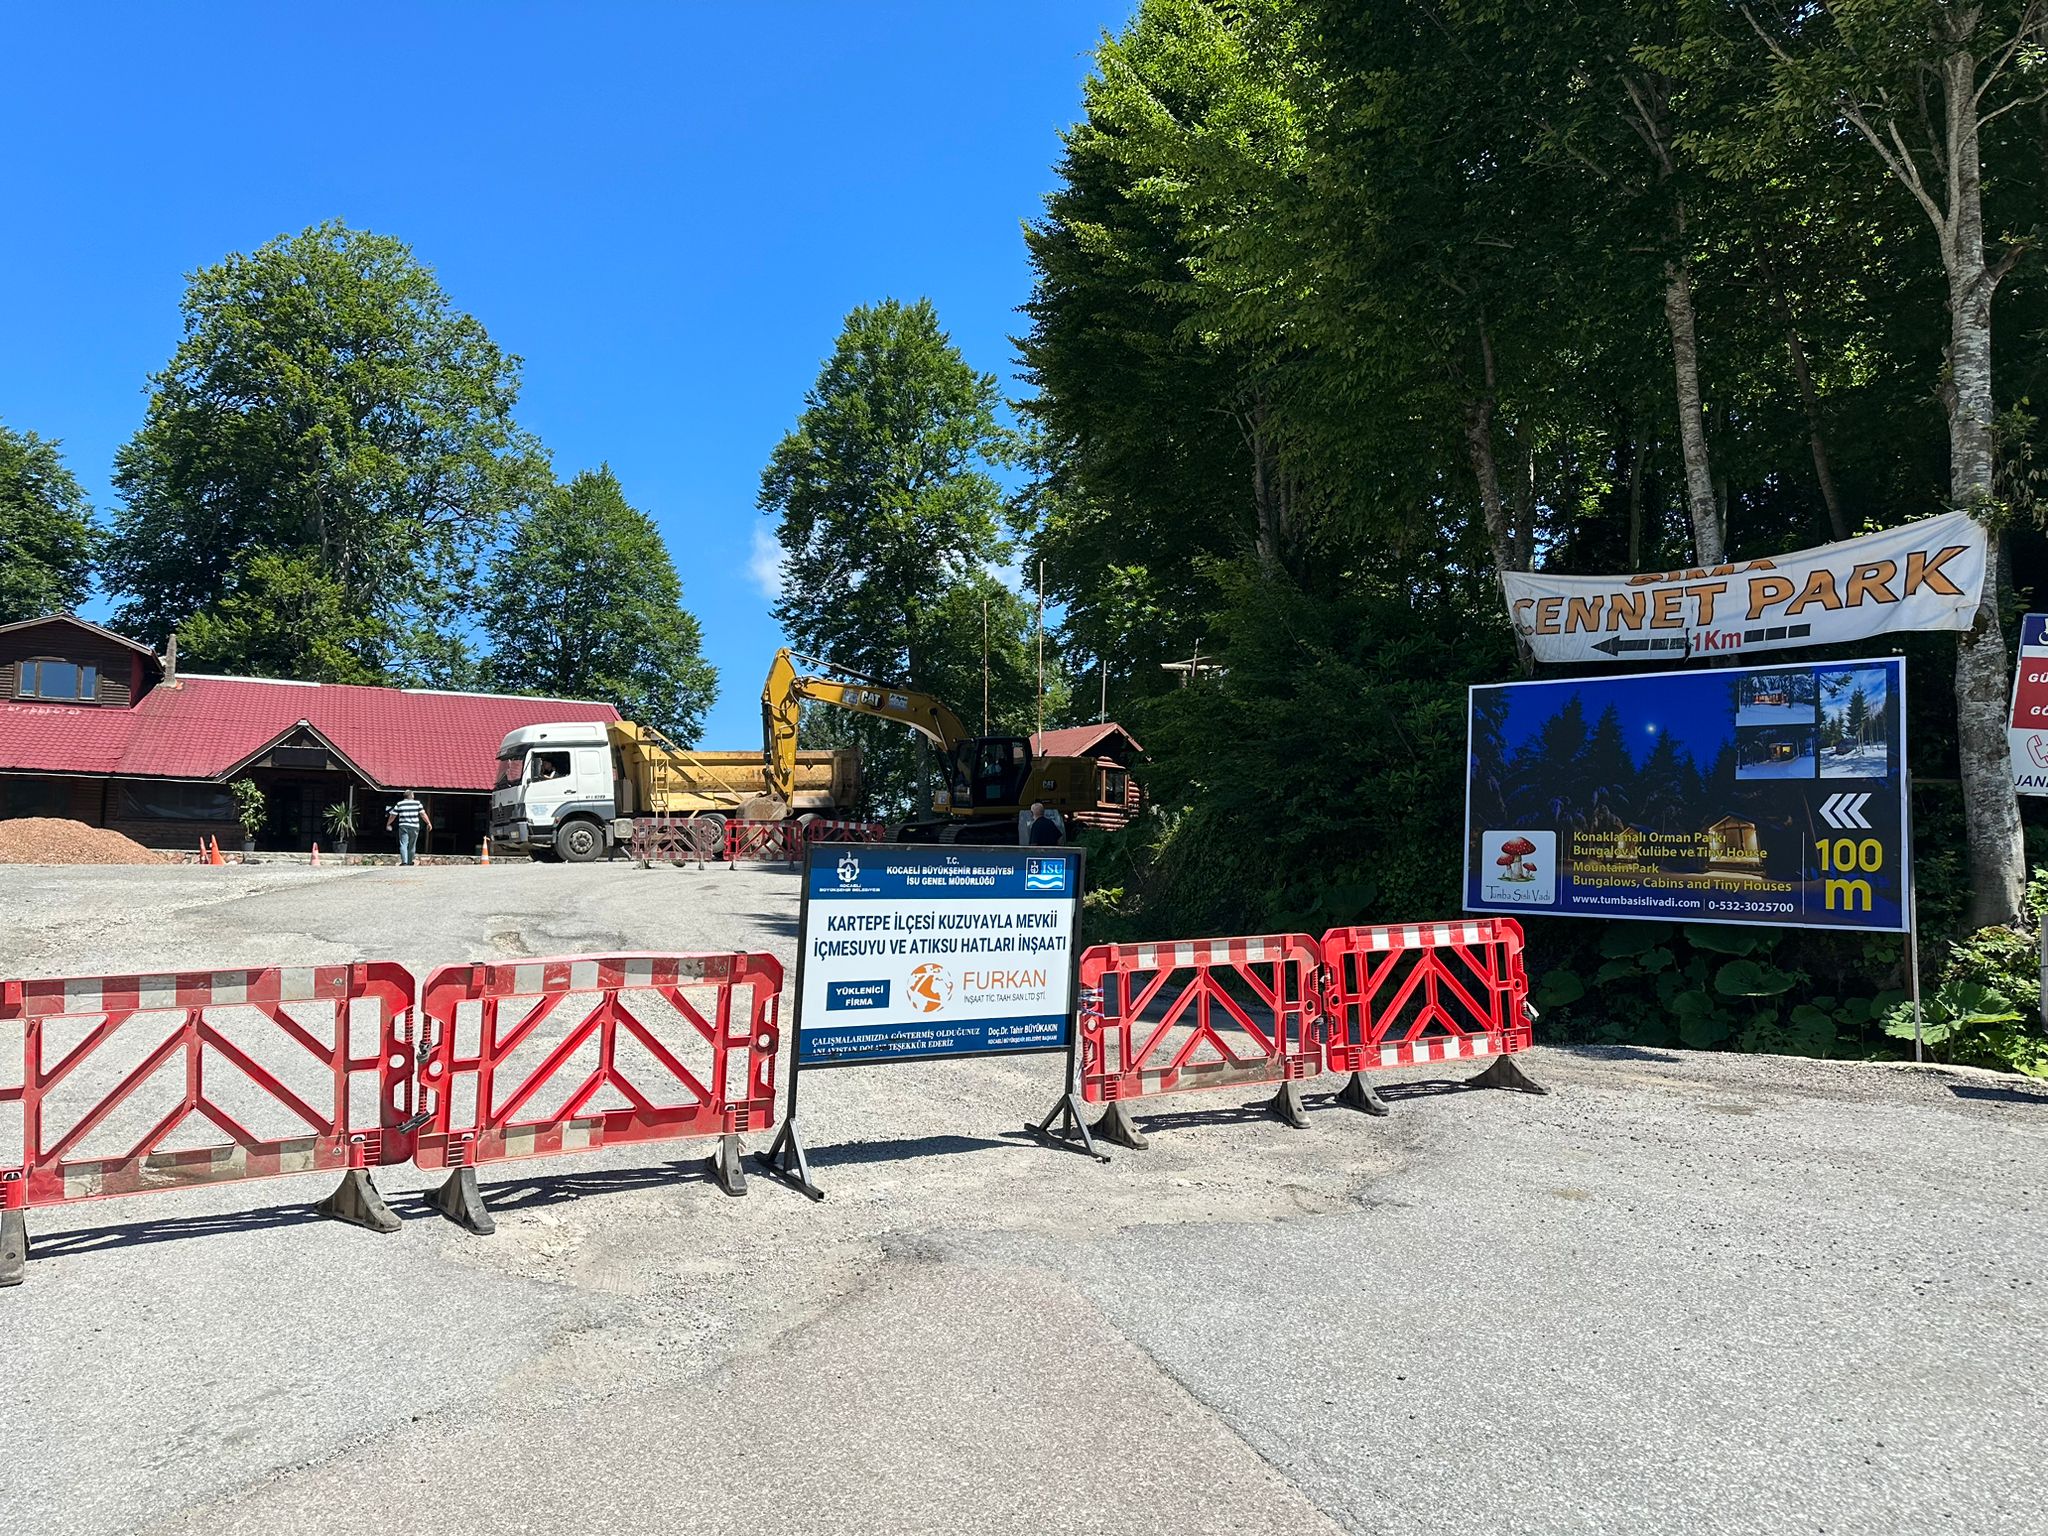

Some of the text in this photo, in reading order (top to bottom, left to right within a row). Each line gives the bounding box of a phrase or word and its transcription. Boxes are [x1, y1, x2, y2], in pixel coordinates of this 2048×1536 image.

[1512, 582, 1728, 636] CENNET
[1745, 546, 1971, 621] PARK
[861, 690, 881, 707] CAT
[2014, 774, 2048, 788] JAN
[1573, 831, 1727, 843] Konaklamalı Orman Parkı
[946, 856, 960, 865] T.C.
[1634, 846, 1677, 857] Kulübe
[1697, 847, 1723, 861] Tiny
[1726, 847, 1768, 858] House
[1815, 838, 1883, 872] 100
[886, 865, 1014, 877] KOCAELİ BÜYÜKŞEHİR BELEDİYESİ
[906, 875, 995, 886] İSU GENEL MÜDÜRLÜĞÜ
[1573, 875, 1792, 893] Bungalows, Cabins and Tiny Houses
[1825, 878, 1872, 911] m
[1572, 895, 1794, 913] www.tumbasislivadi.com 0-532-3025700
[827, 910, 1058, 935] KARTEPE İLÇESİ KUZUYAYLA MEVKİİ
[814, 933, 1066, 962] İÇMESUYU VE ATIKSU HATLARI İNŞAATI
[963, 969, 1047, 990] FURKAN
[835, 984, 884, 996] YÜKLENİCİ
[845, 997, 873, 1006] FİRMA
[812, 1027, 981, 1047] ÇALIŞMALARIMIZDA GÖSTERMİŞ OLDUĞUNUZ
[1010, 1025, 1024, 1035] Tahir
[888, 1039, 927, 1052] TEŞEKKÜR
[928, 1038, 954, 1048] EDERİZ
